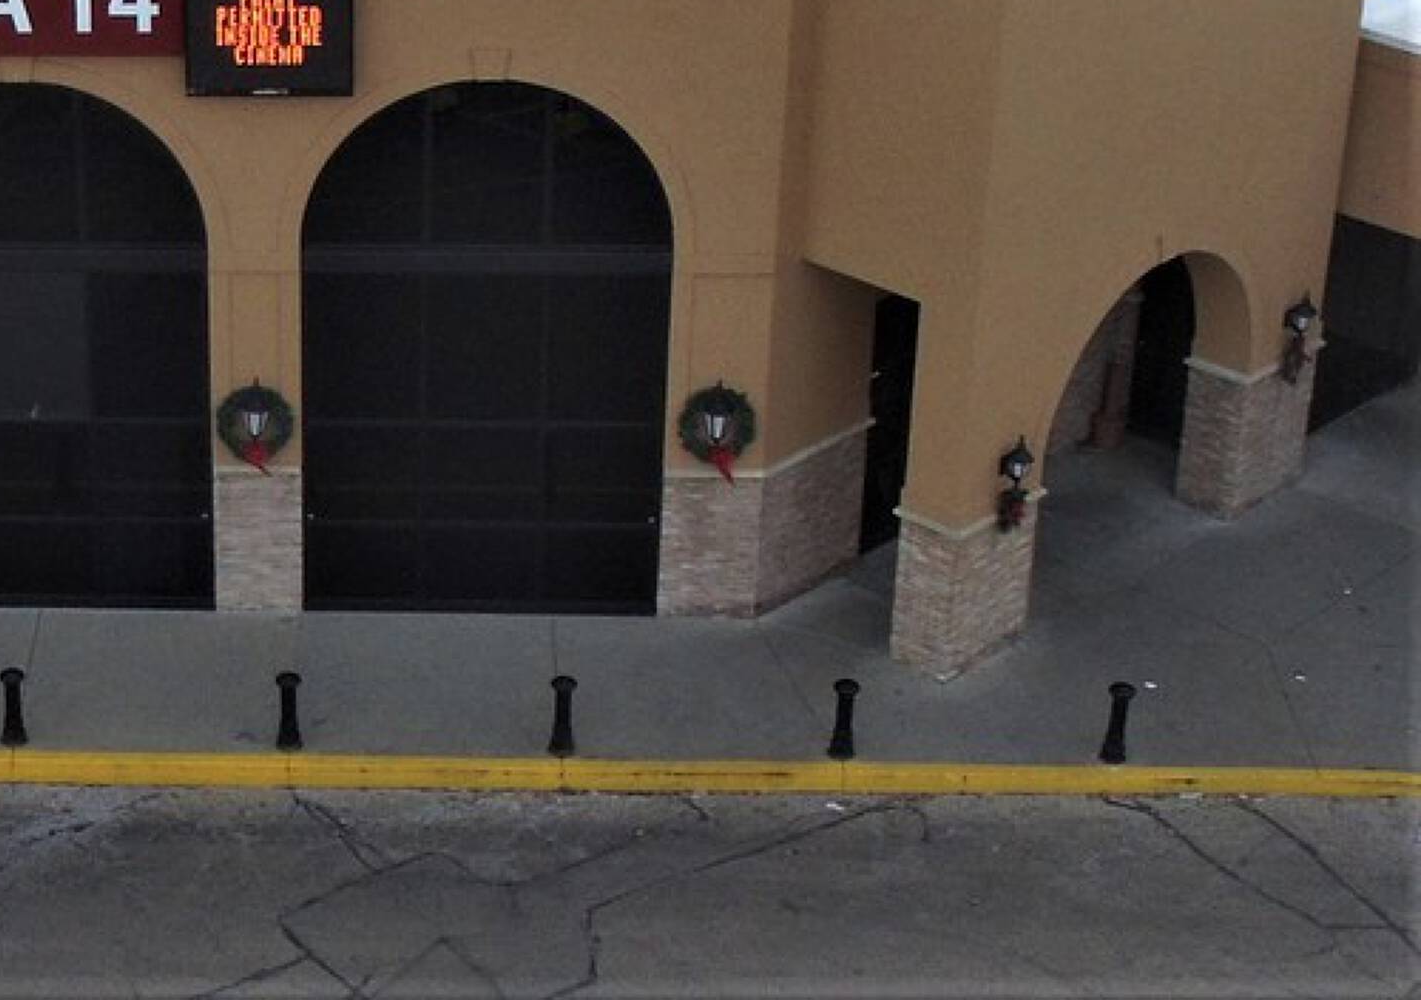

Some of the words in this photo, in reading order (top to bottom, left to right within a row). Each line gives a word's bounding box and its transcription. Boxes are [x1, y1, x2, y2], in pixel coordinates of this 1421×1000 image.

[216, 7, 323, 26] PERMITTED
[216, 26, 280, 46] INSIDE
[290, 26, 323, 46] THE
[235, 45, 304, 66] CINEMA
